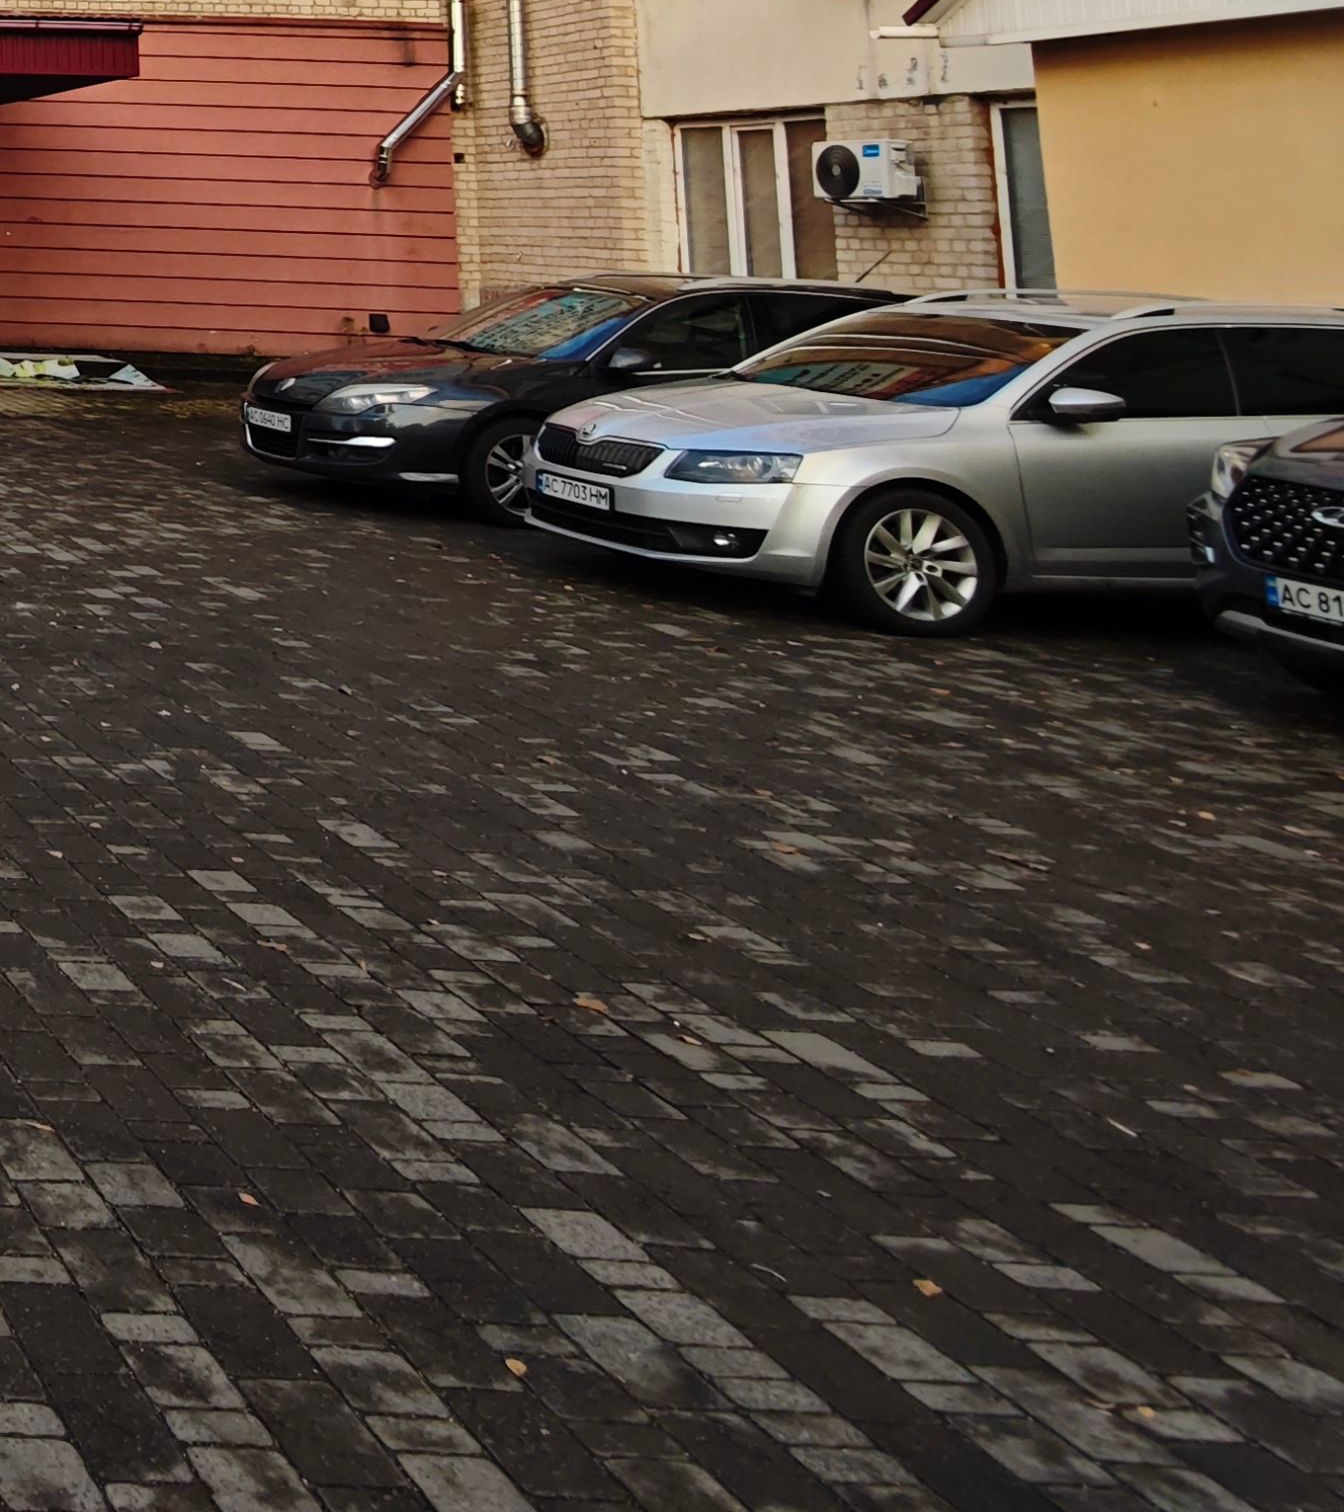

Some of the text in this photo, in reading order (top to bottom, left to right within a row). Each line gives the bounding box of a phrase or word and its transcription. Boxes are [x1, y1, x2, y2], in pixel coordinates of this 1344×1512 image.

[543, 476, 608, 506] AC 7703 HM
[1281, 584, 1311, 609] AC
